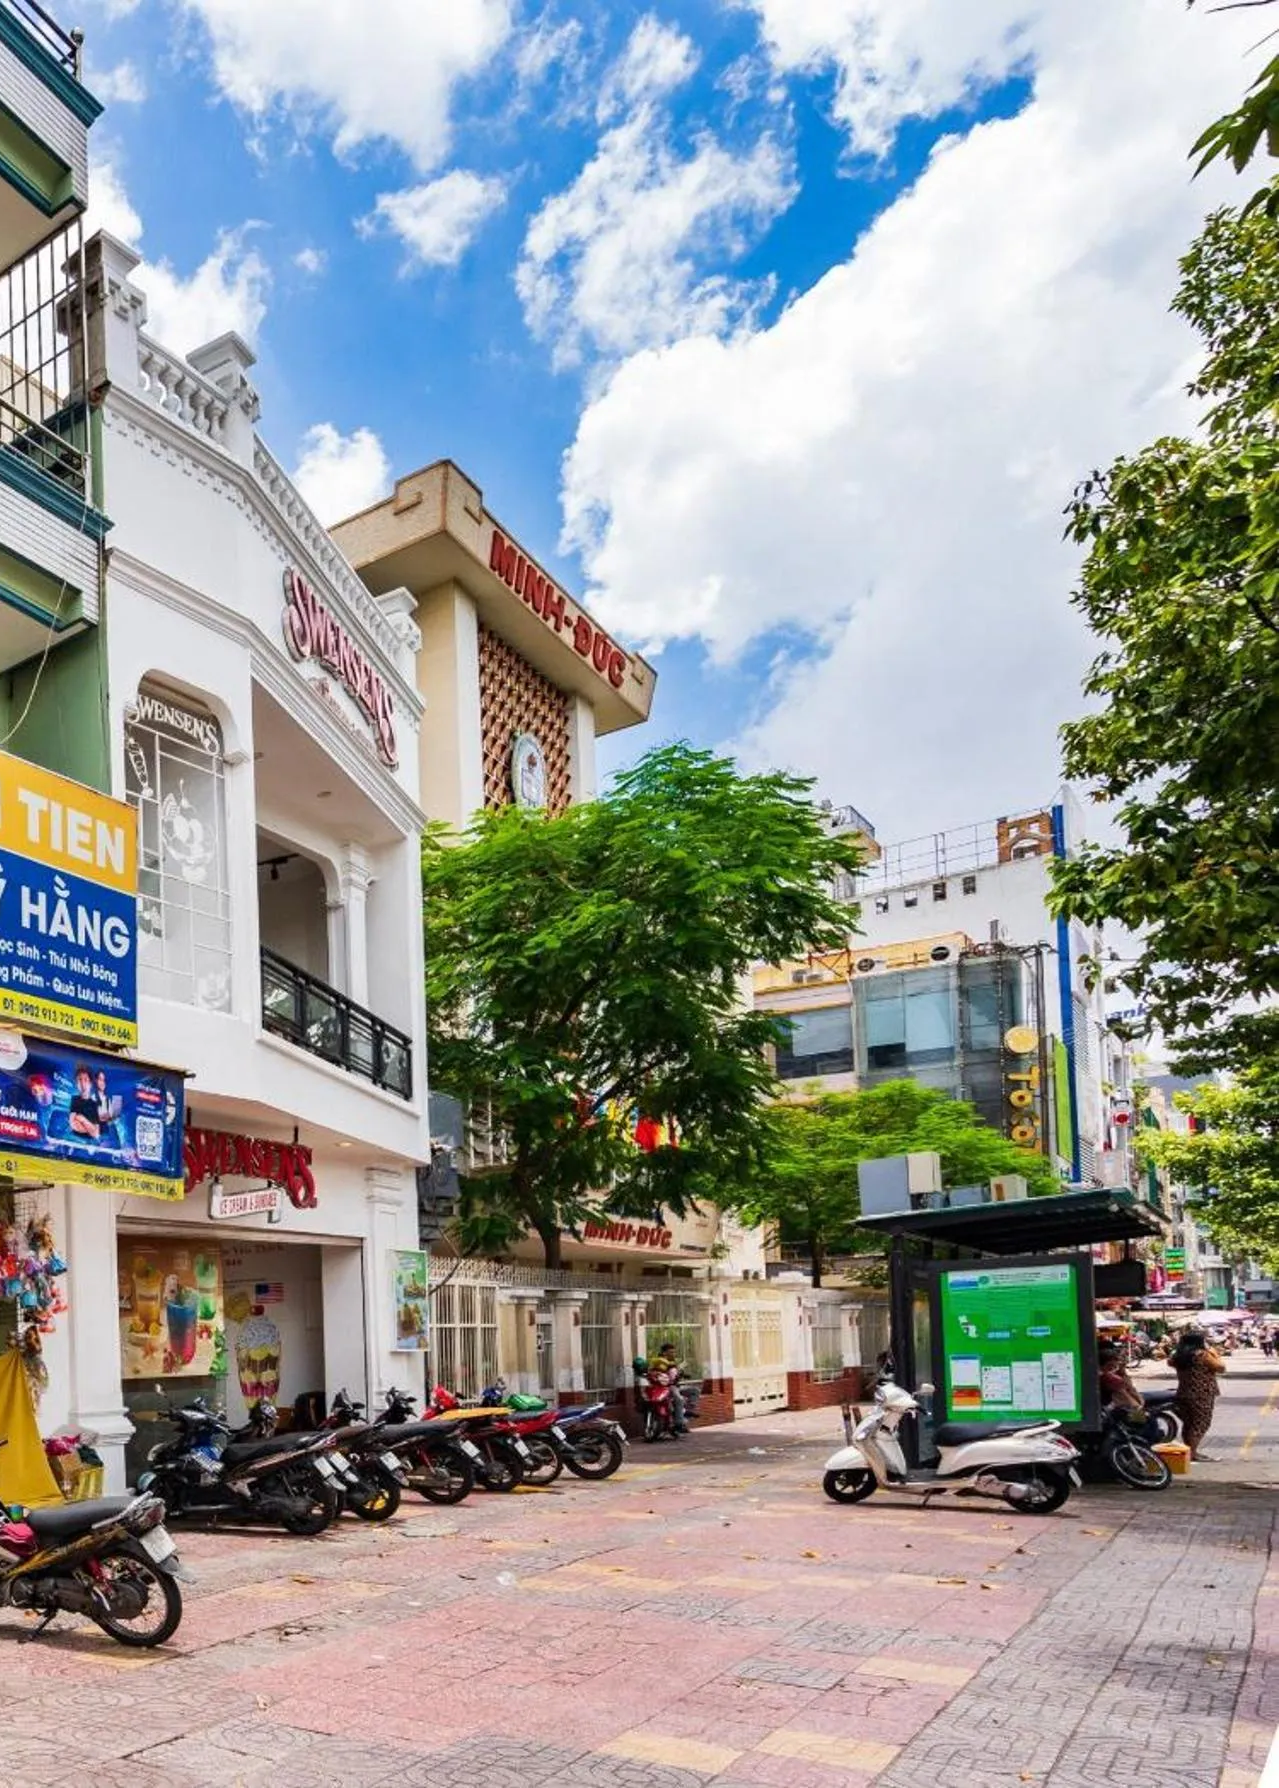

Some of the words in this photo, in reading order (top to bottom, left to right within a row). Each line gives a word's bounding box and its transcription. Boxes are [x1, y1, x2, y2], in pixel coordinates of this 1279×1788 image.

[283, 566, 399, 772] SWENSEN'S
[126, 694, 220, 757] SWENSEN'S
[18, 787, 125, 875] TIEN
[17, 940, 40, 961] Sinh
[48, 949, 67, 969] Thú
[20, 873, 131, 958] HẰNG
[52, 976, 76, 998] Quà
[183, 1127, 318, 1209] WENSEN'S
